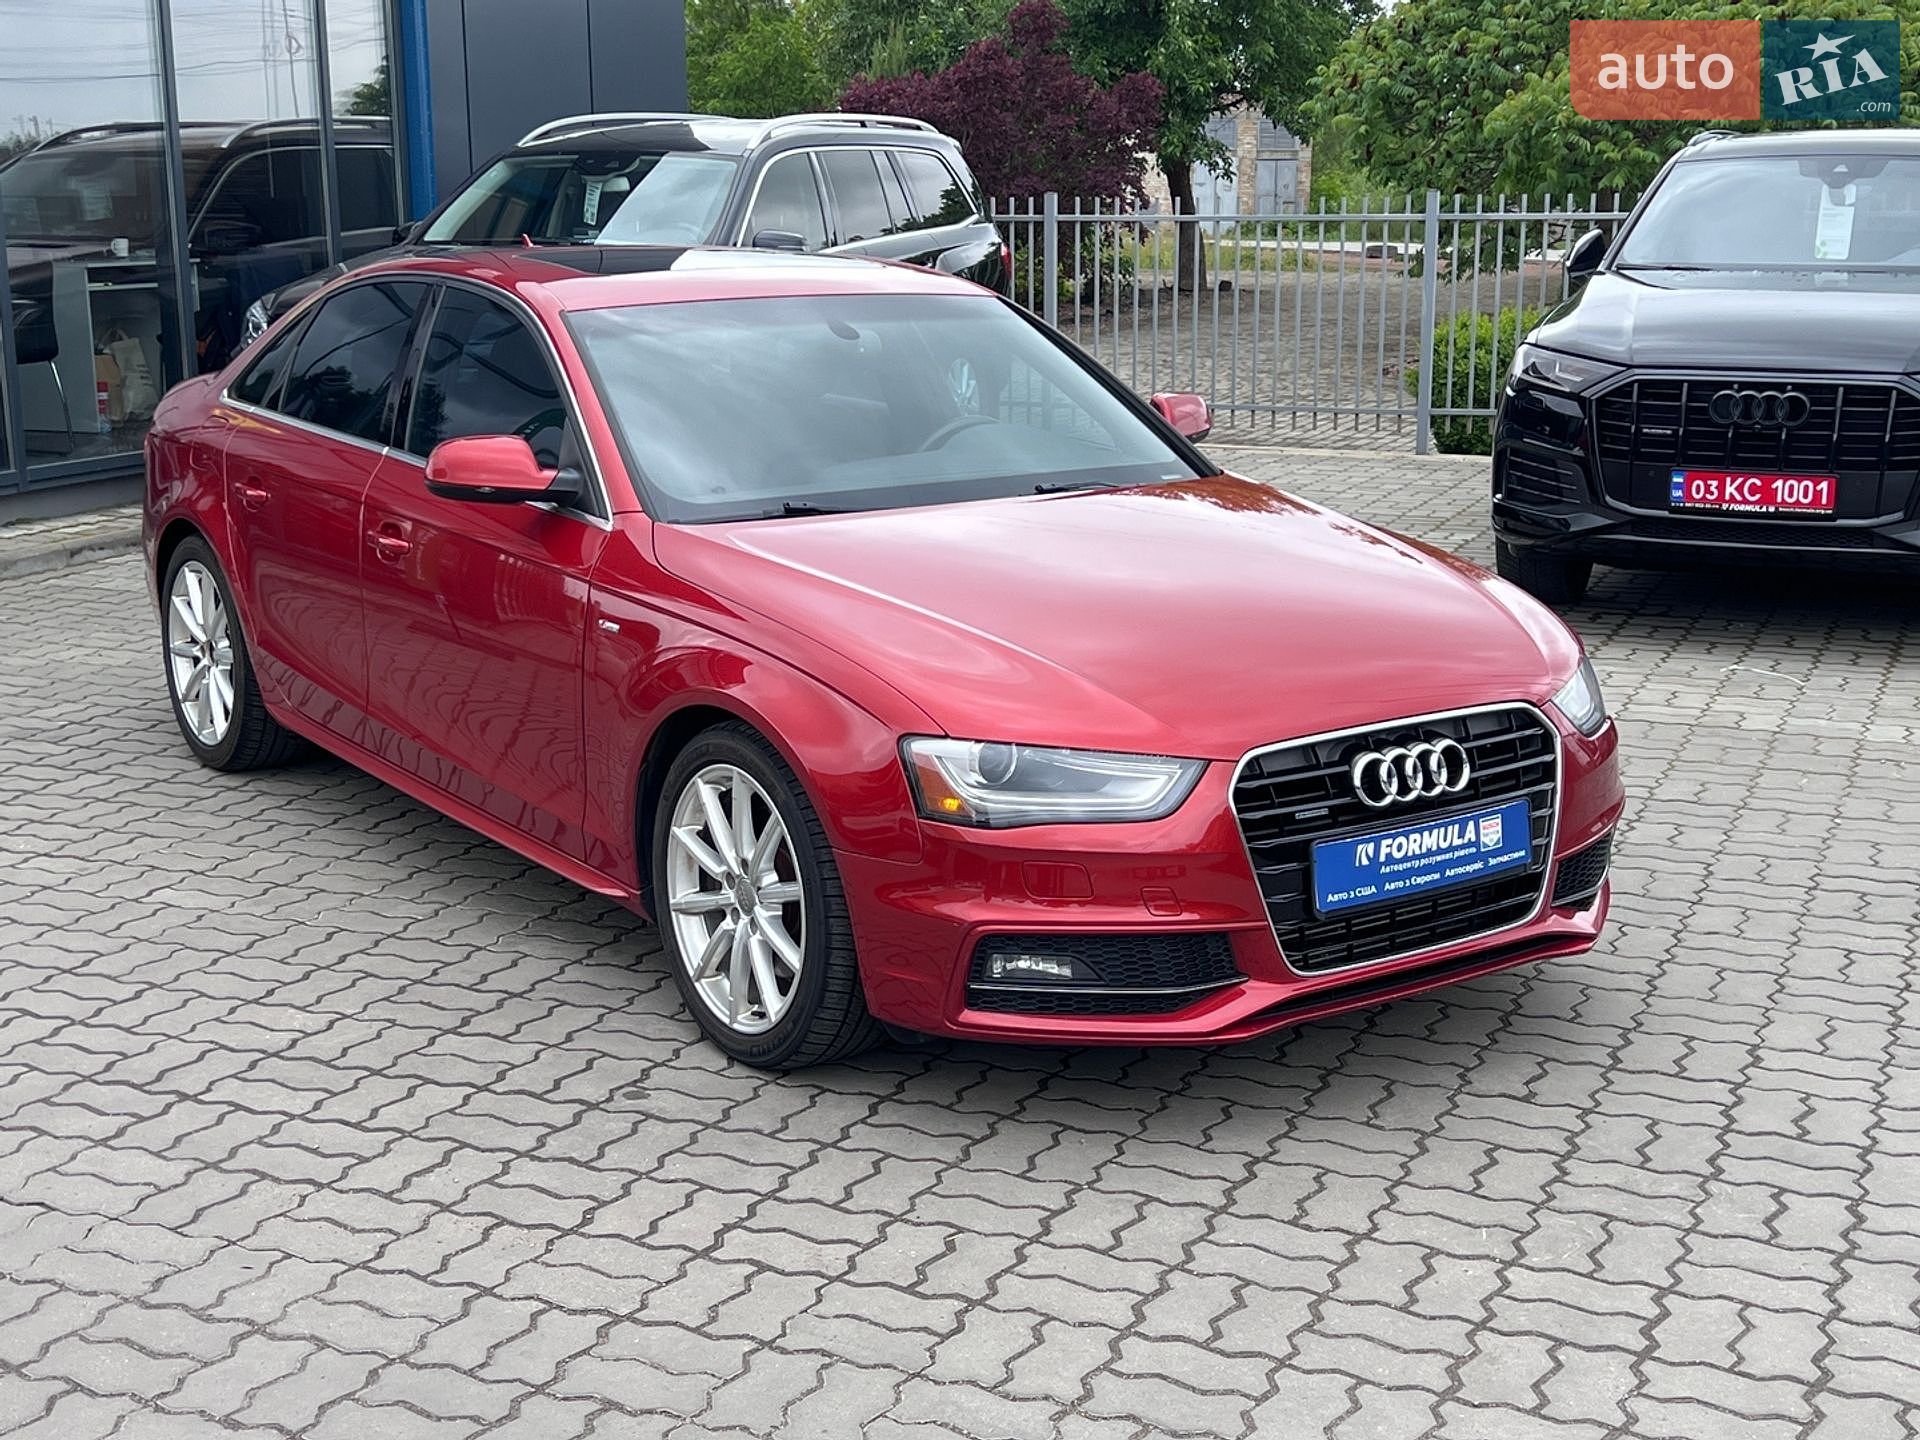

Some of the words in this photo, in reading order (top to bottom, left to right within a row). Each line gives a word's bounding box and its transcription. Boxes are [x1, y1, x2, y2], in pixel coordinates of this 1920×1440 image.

[1672, 489, 1683, 498] UA
[1691, 479, 1719, 500] 03
[1724, 477, 1762, 502] KC
[1771, 478, 1829, 505] 1001
[1729, 503, 1767, 512] FORMULA
[1379, 820, 1476, 862] FORMULA
[1380, 859, 1420, 874] Автоцентр
[1326, 892, 1348, 903] Авто
[1355, 885, 1377, 897] США
[1384, 881, 1404, 891] Авто
[1444, 860, 1485, 877] Автосервіс
